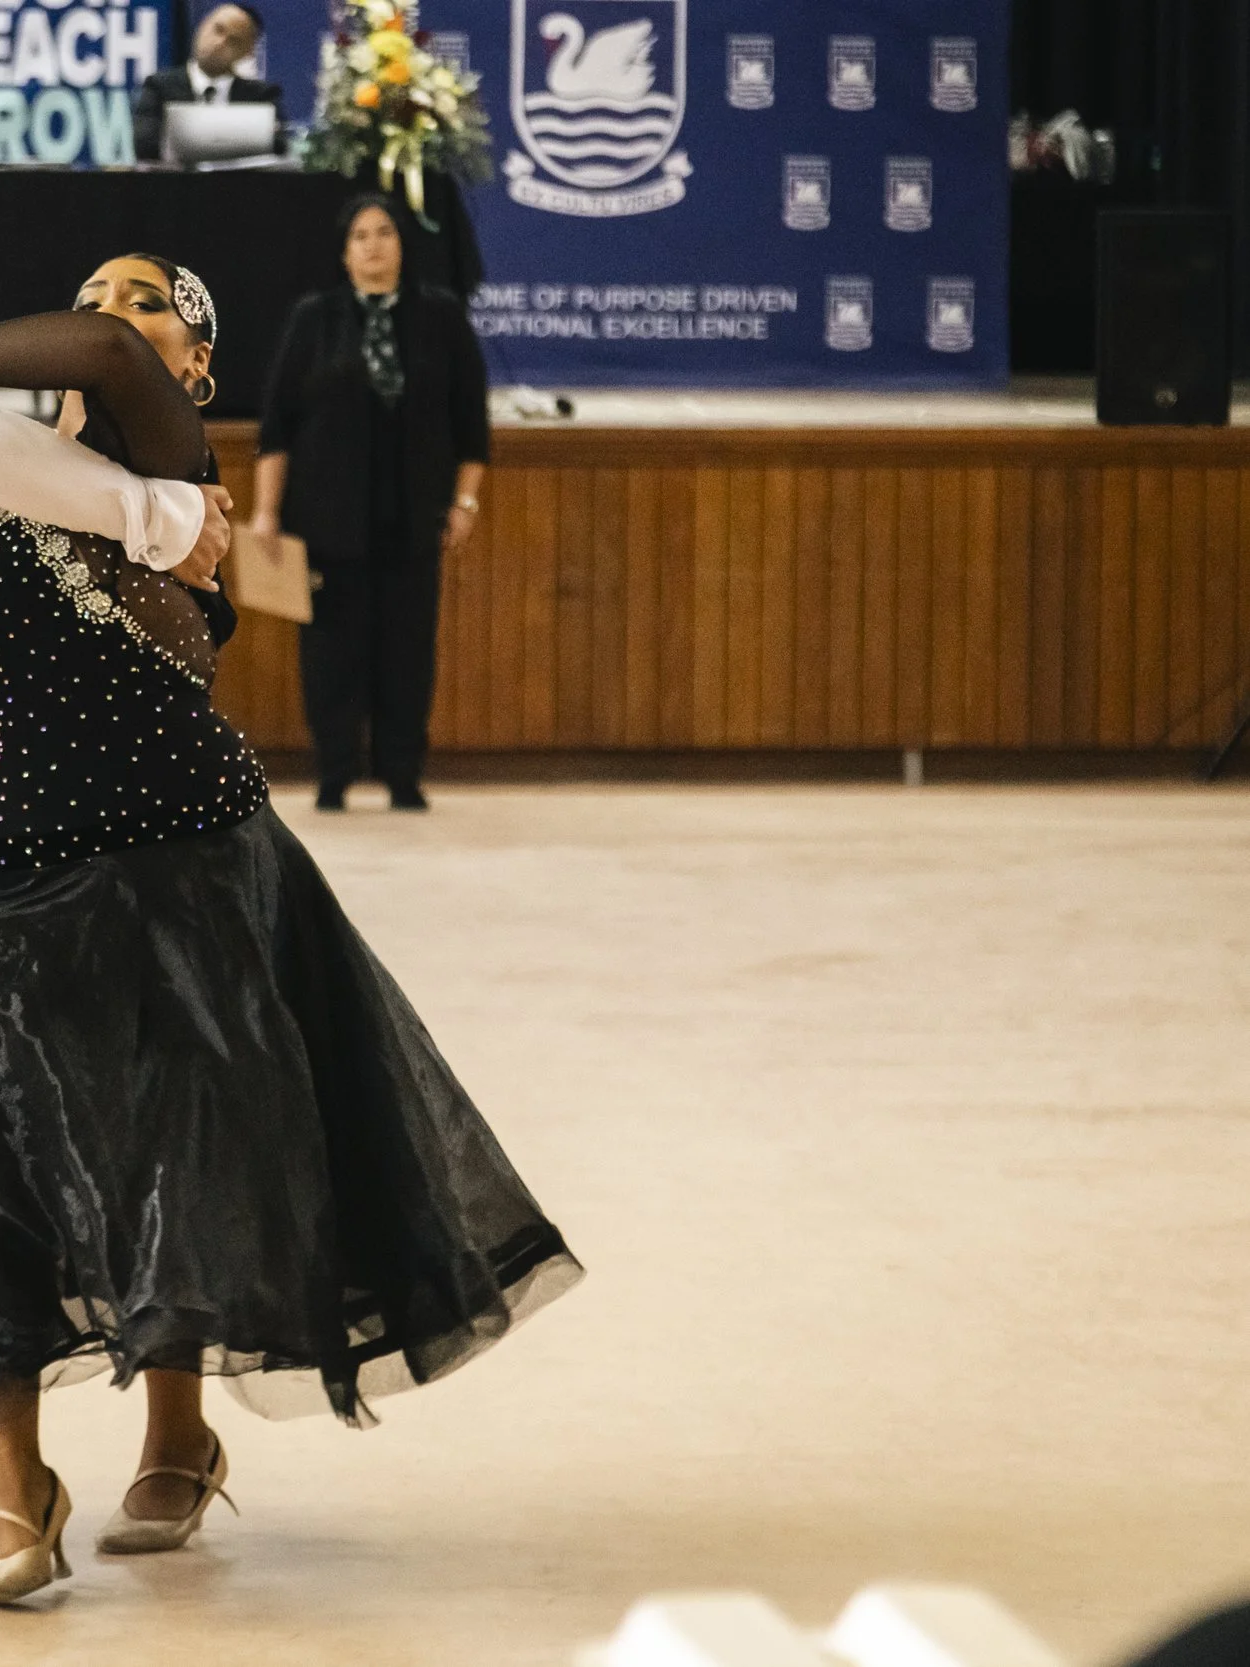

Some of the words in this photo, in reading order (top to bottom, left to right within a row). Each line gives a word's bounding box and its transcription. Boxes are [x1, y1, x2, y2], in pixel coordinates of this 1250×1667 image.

[532, 285, 568, 310] OF
[573, 286, 697, 312] PURPOSE
[703, 287, 798, 313] DRIVEN
[602, 314, 769, 339] EXCELLENCE
